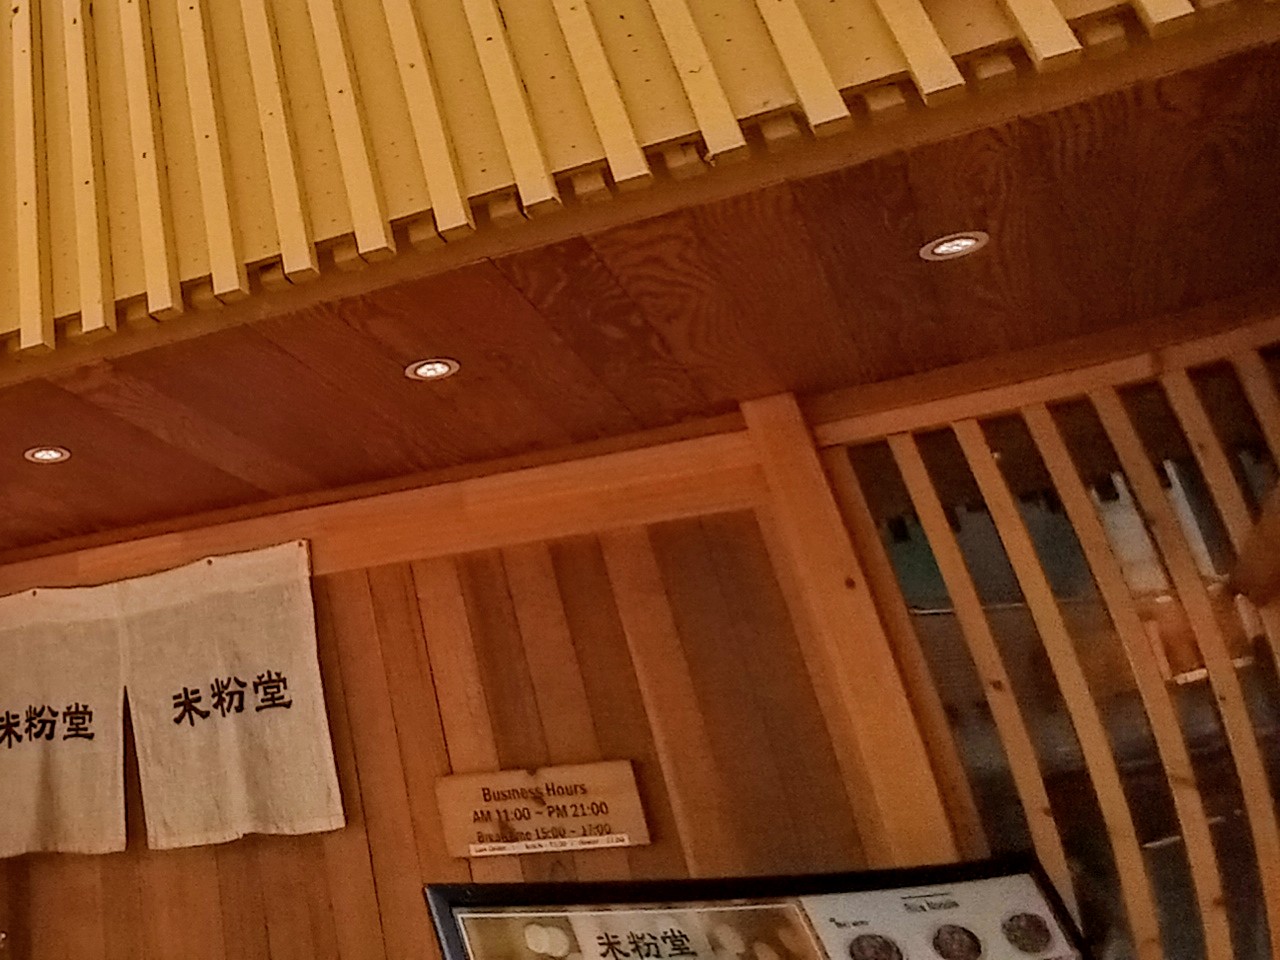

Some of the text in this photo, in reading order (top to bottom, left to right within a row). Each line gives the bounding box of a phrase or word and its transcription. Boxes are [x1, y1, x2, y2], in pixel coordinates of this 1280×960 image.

[172, 669, 294, 728] 米粉堂
[481, 782, 588, 803] Business Hours
[472, 809, 492, 823] AM
[496, 806, 531, 823] 11:00
[547, 804, 568, 819] PM
[572, 800, 609, 818] 21:00
[596, 928, 698, 960] 米粉堂
